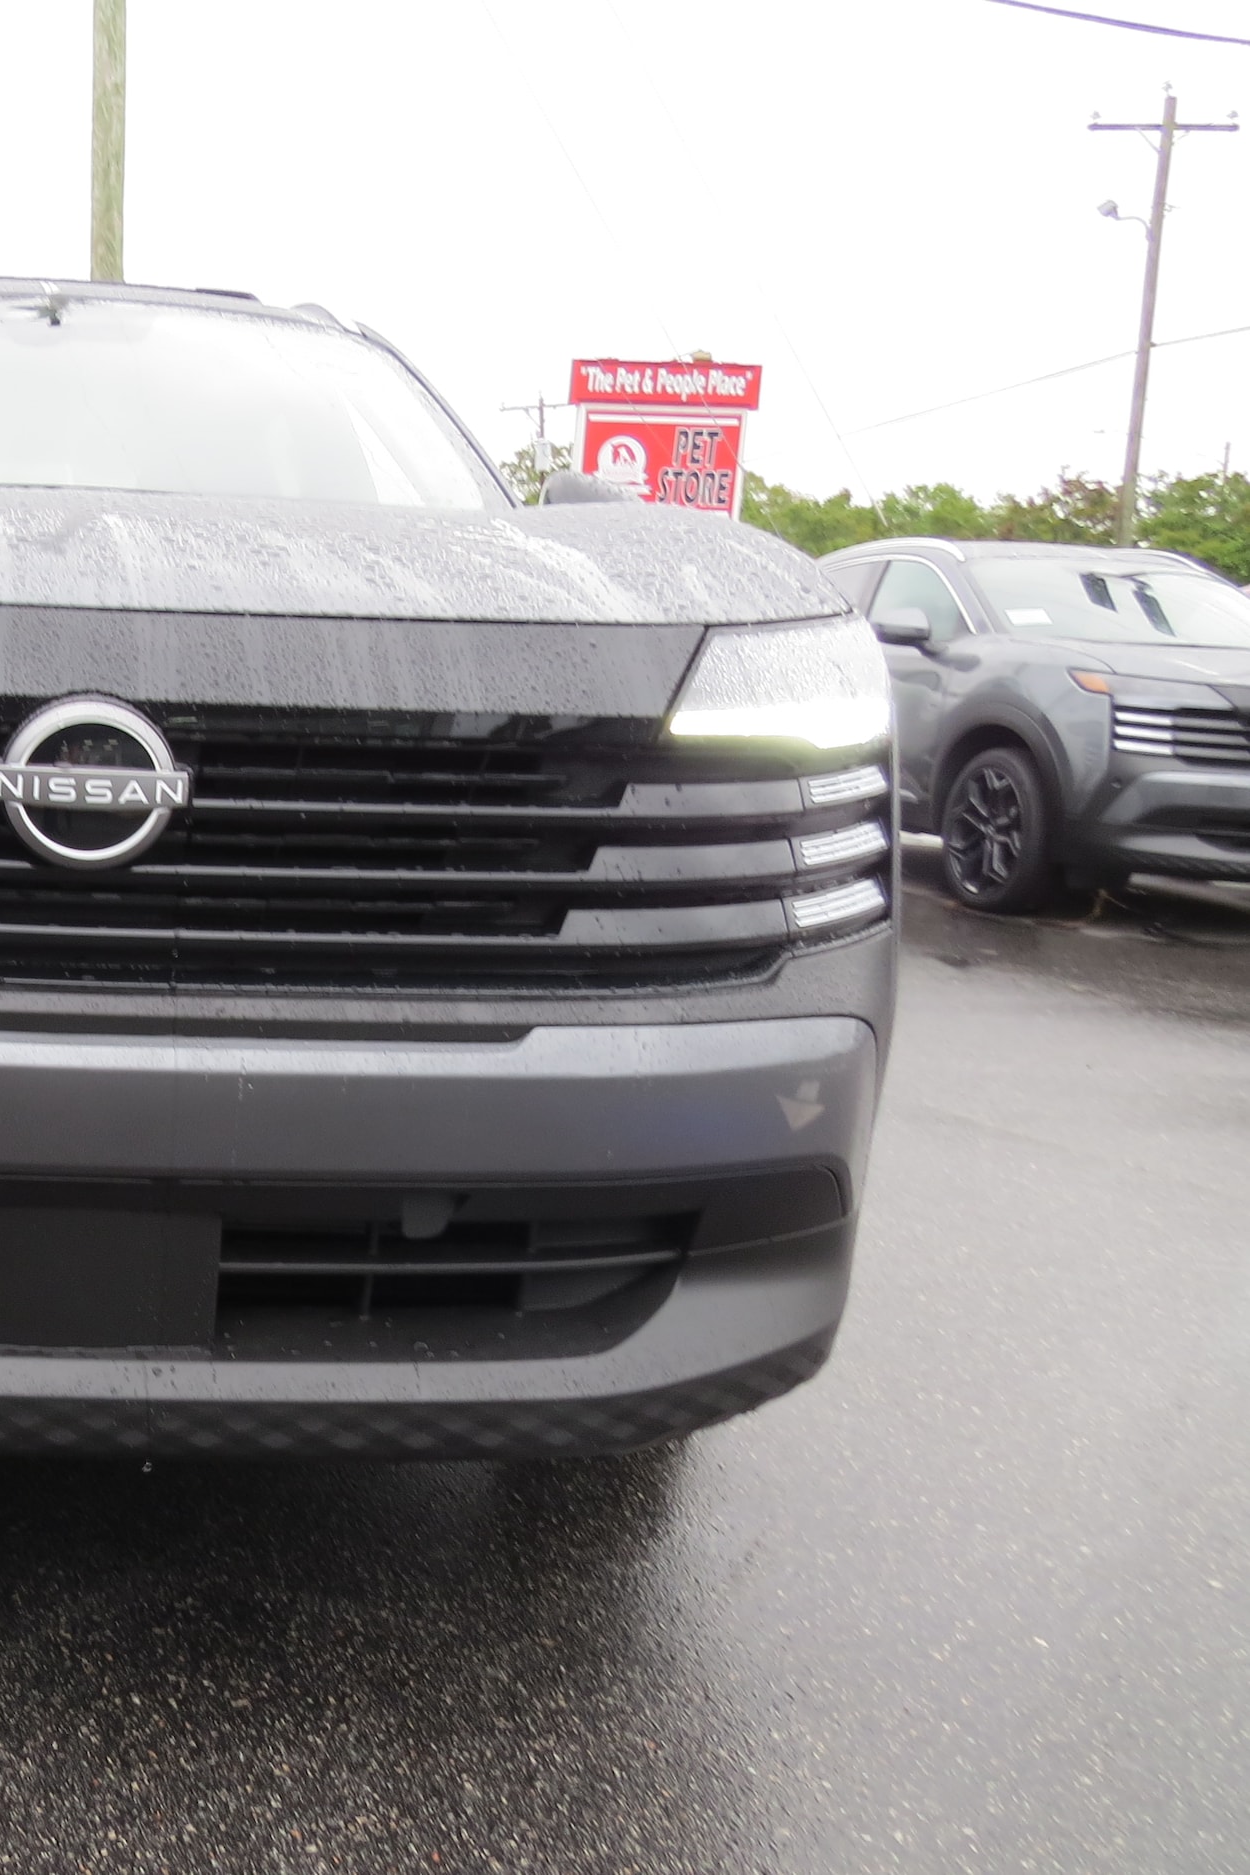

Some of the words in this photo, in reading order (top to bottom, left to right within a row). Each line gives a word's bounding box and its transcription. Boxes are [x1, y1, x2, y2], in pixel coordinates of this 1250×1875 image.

[616, 367, 641, 394] Pet
[642, 369, 654, 394] &
[657, 368, 706, 402] People
[673, 427, 722, 467] PET
[657, 467, 732, 507] STORE
